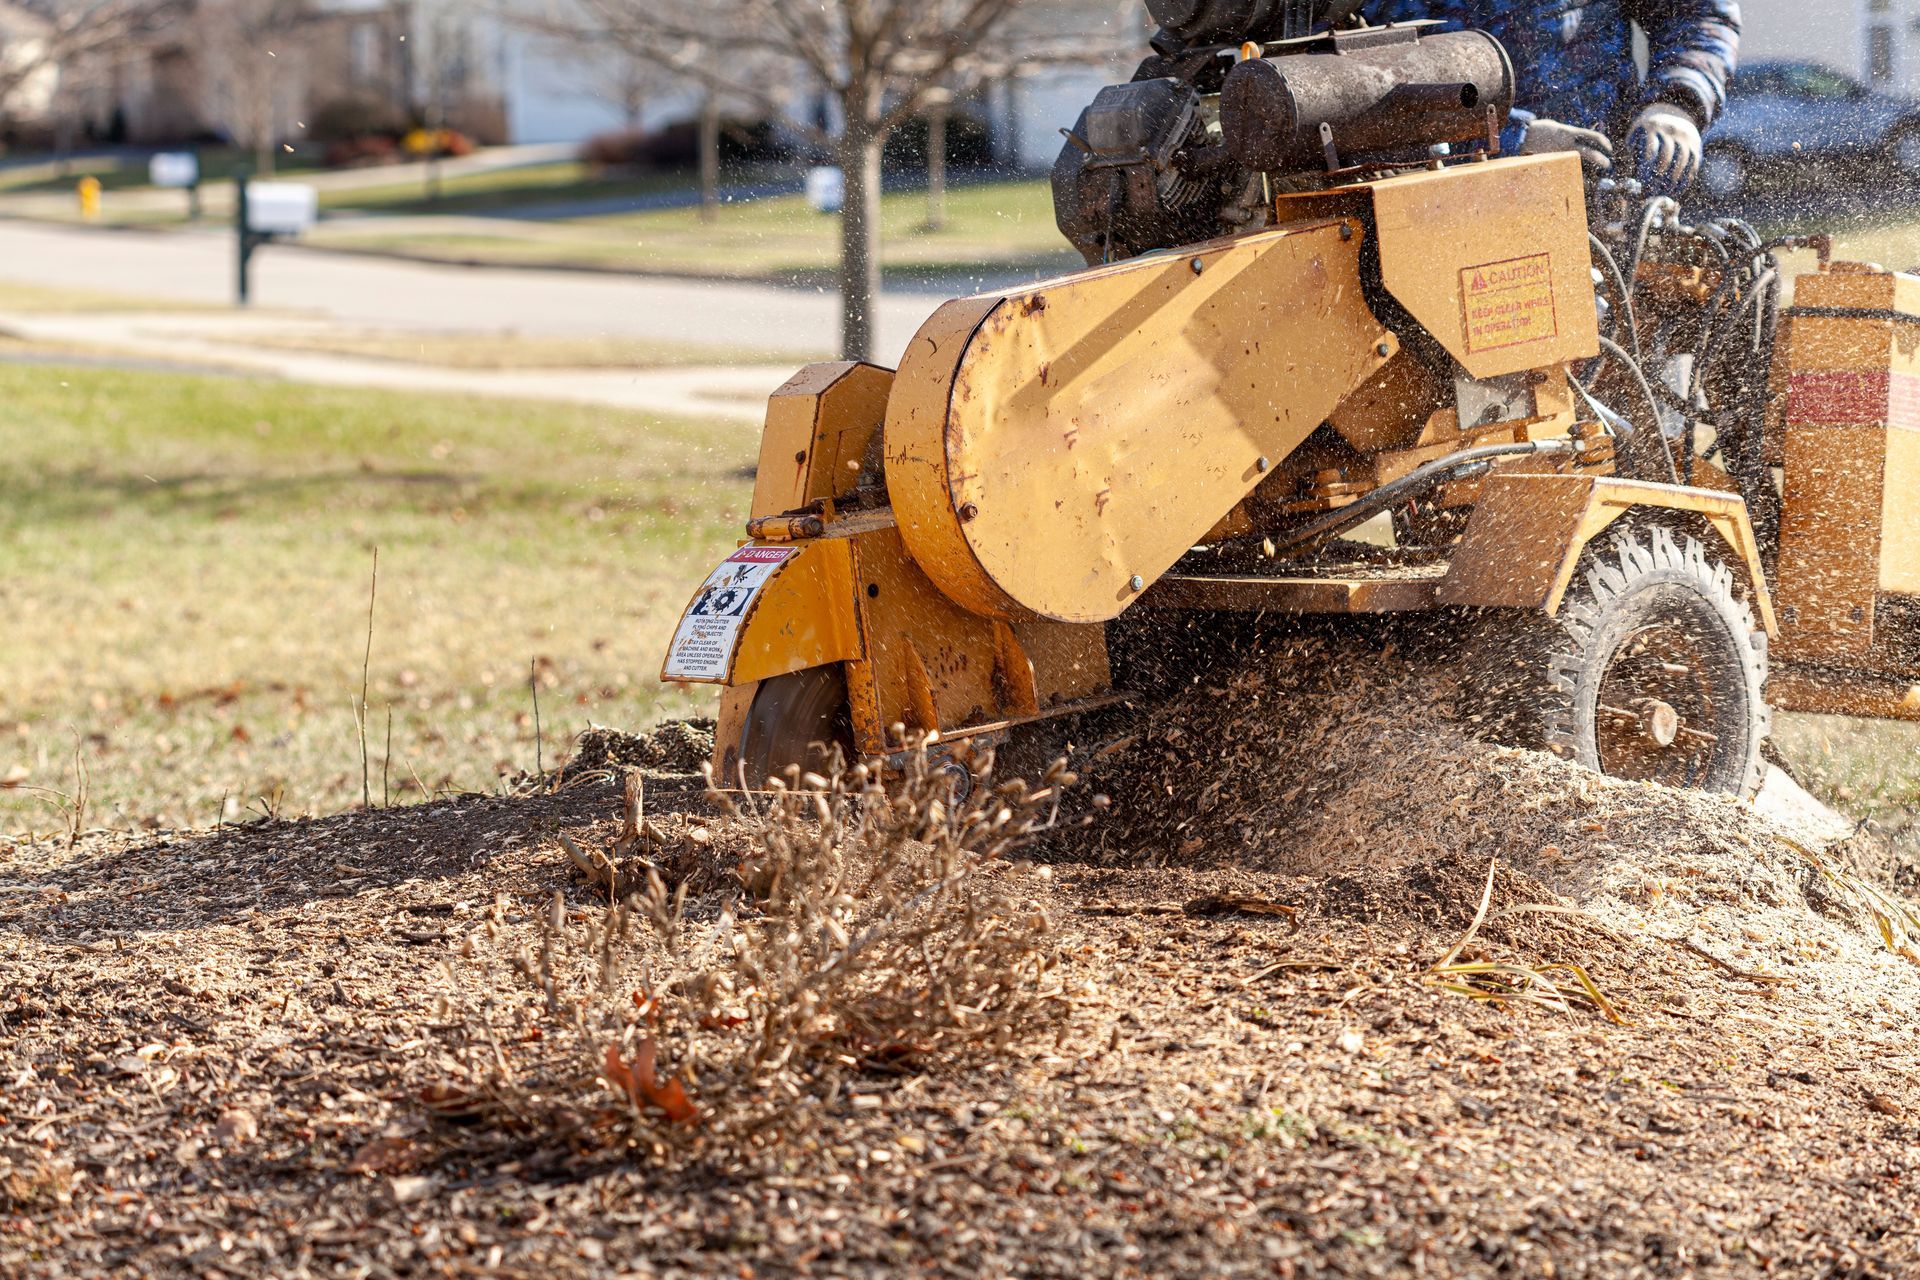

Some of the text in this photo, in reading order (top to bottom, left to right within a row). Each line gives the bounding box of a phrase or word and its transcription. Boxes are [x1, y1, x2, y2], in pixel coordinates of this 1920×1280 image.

[1490, 264, 1545, 284] CAUTION
[1471, 307, 1493, 319] KEEP
[1495, 301, 1522, 314] CLEAR
[746, 550, 788, 559] DANGER
